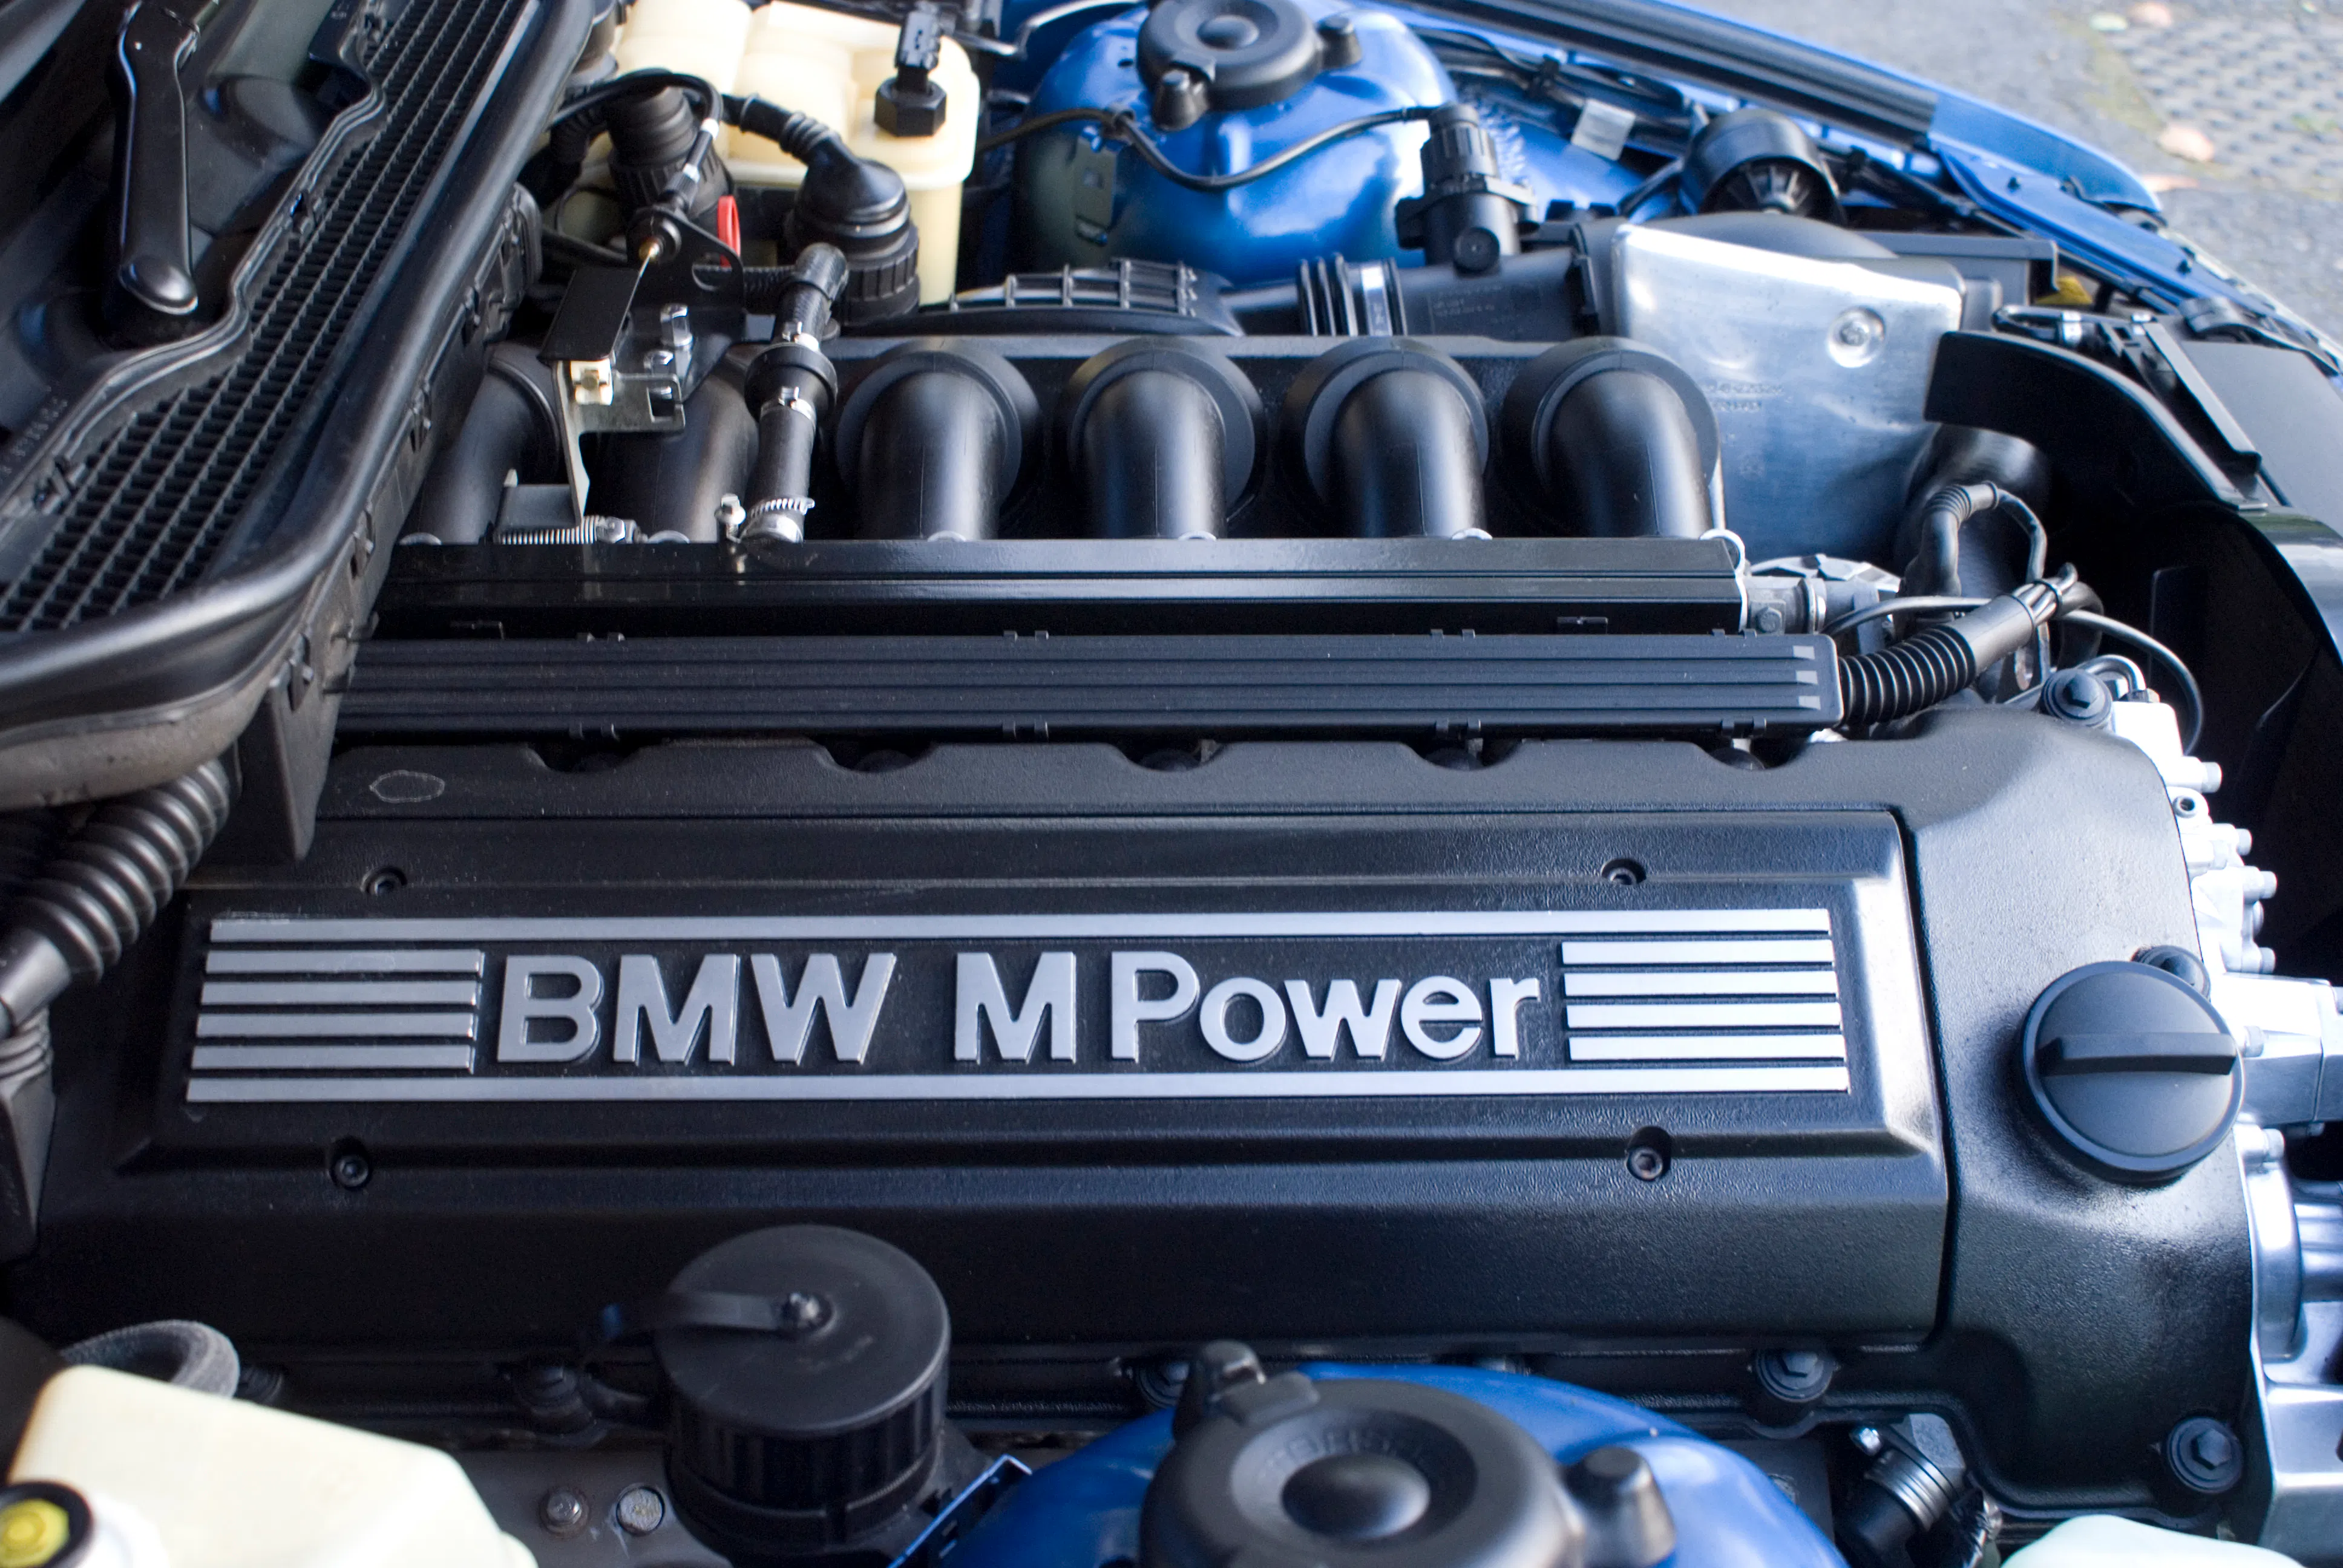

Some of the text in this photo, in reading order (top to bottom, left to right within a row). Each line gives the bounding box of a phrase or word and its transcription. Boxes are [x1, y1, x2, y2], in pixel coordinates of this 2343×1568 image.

[497, 950, 1540, 1065] BMW M Power
